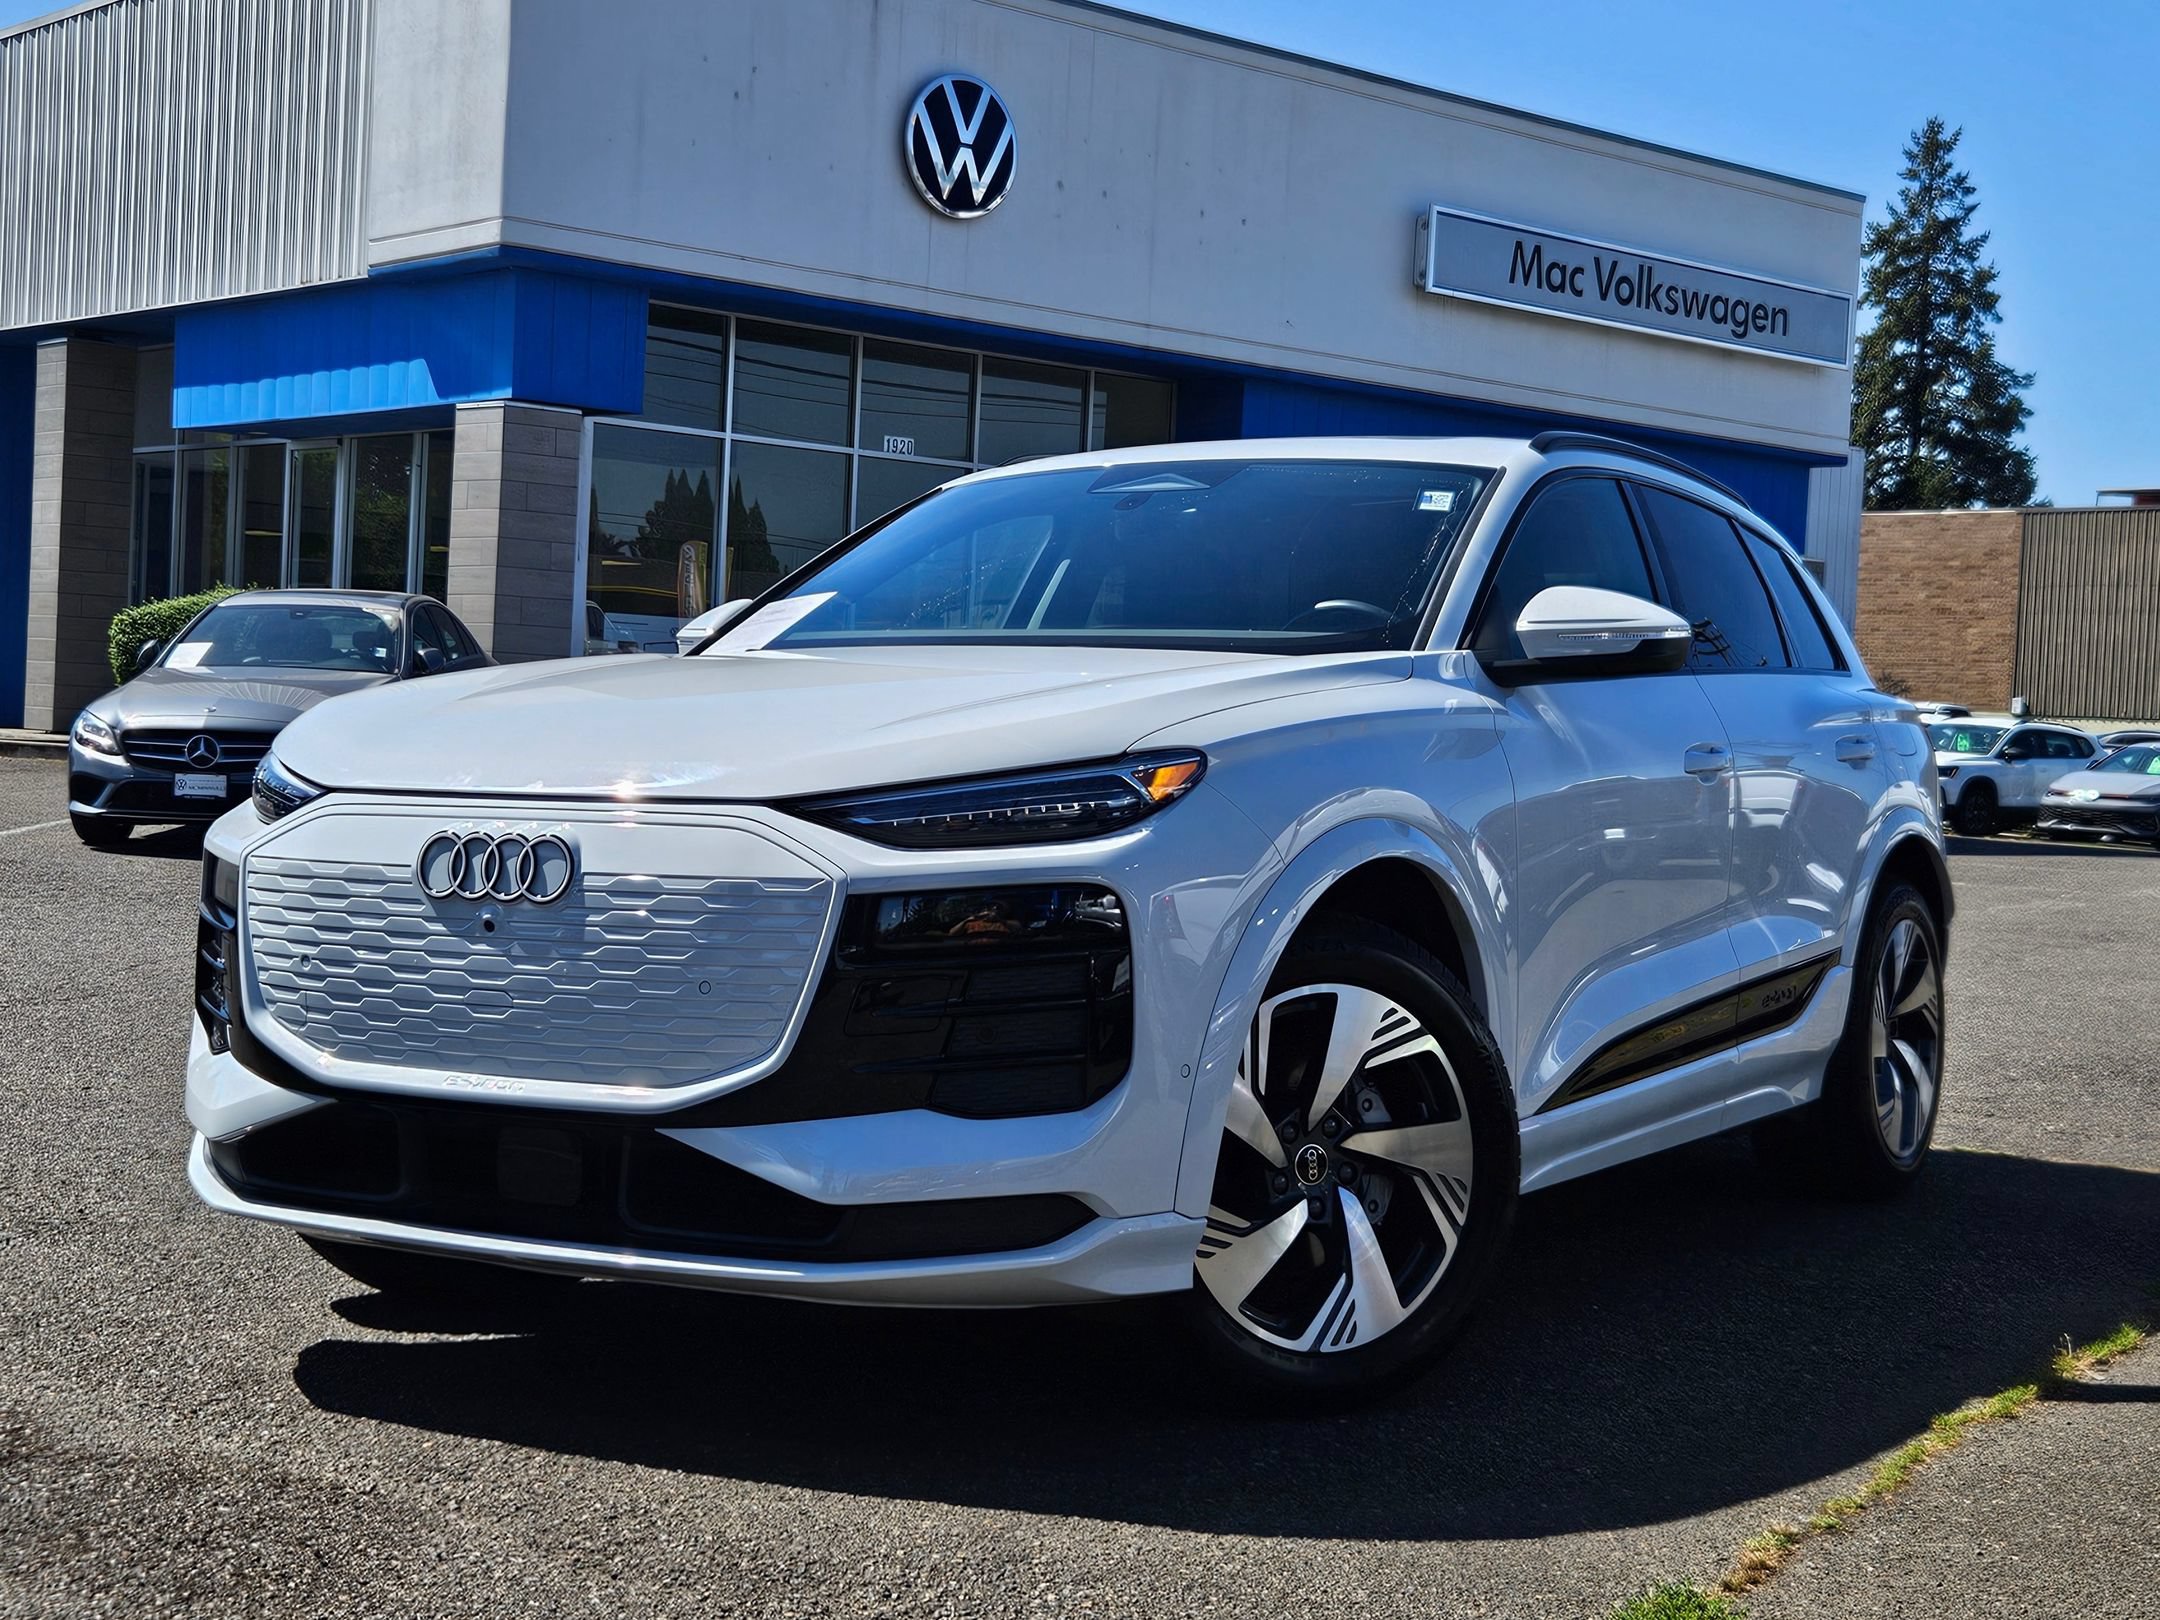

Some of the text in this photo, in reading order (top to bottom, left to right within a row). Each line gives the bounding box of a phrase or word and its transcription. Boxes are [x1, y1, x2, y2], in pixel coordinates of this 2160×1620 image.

[908, 75, 1016, 214] VW
[1508, 240, 1789, 339] Mac Volkswagen
[886, 438, 913, 455] 1920
